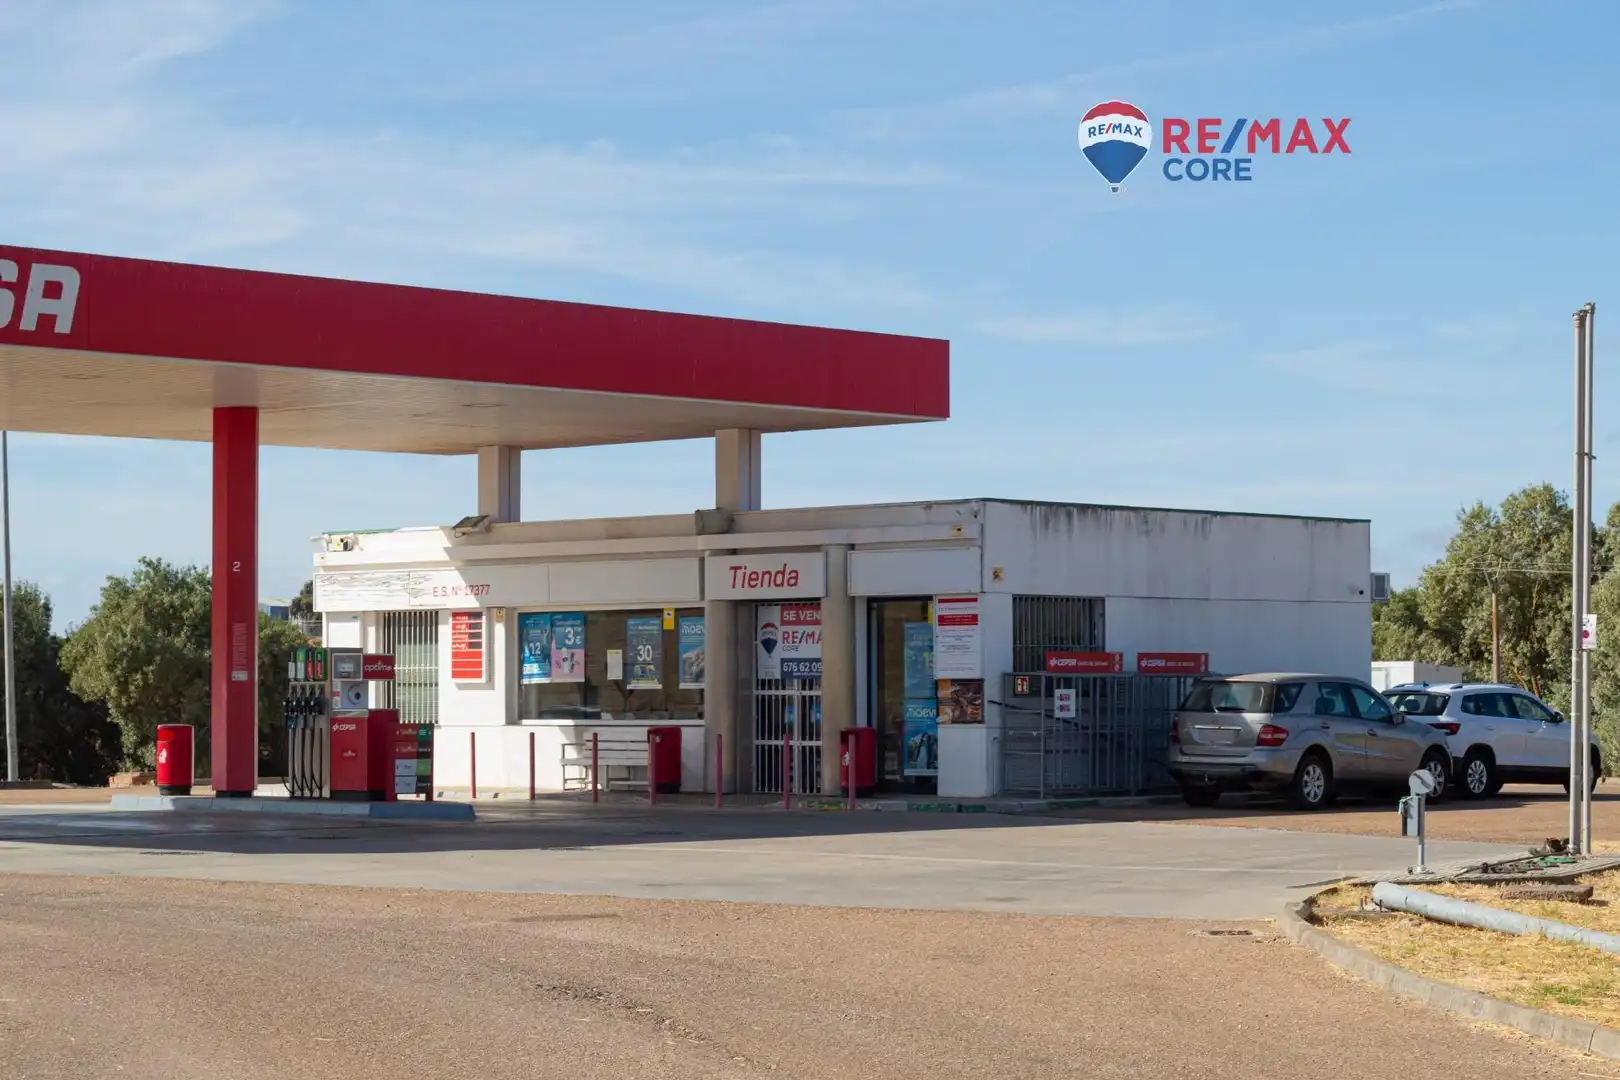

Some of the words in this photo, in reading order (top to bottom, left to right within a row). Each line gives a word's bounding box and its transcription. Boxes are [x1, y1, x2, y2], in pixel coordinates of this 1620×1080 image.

[232, 561, 241, 572] 2
[729, 563, 799, 589] Tienda
[464, 584, 490, 597] 17377
[783, 610, 797, 621] SE
[529, 642, 541, 655] 12
[637, 646, 652, 661] 30
[783, 662, 798, 672] 676
[799, 662, 810, 672] 62
